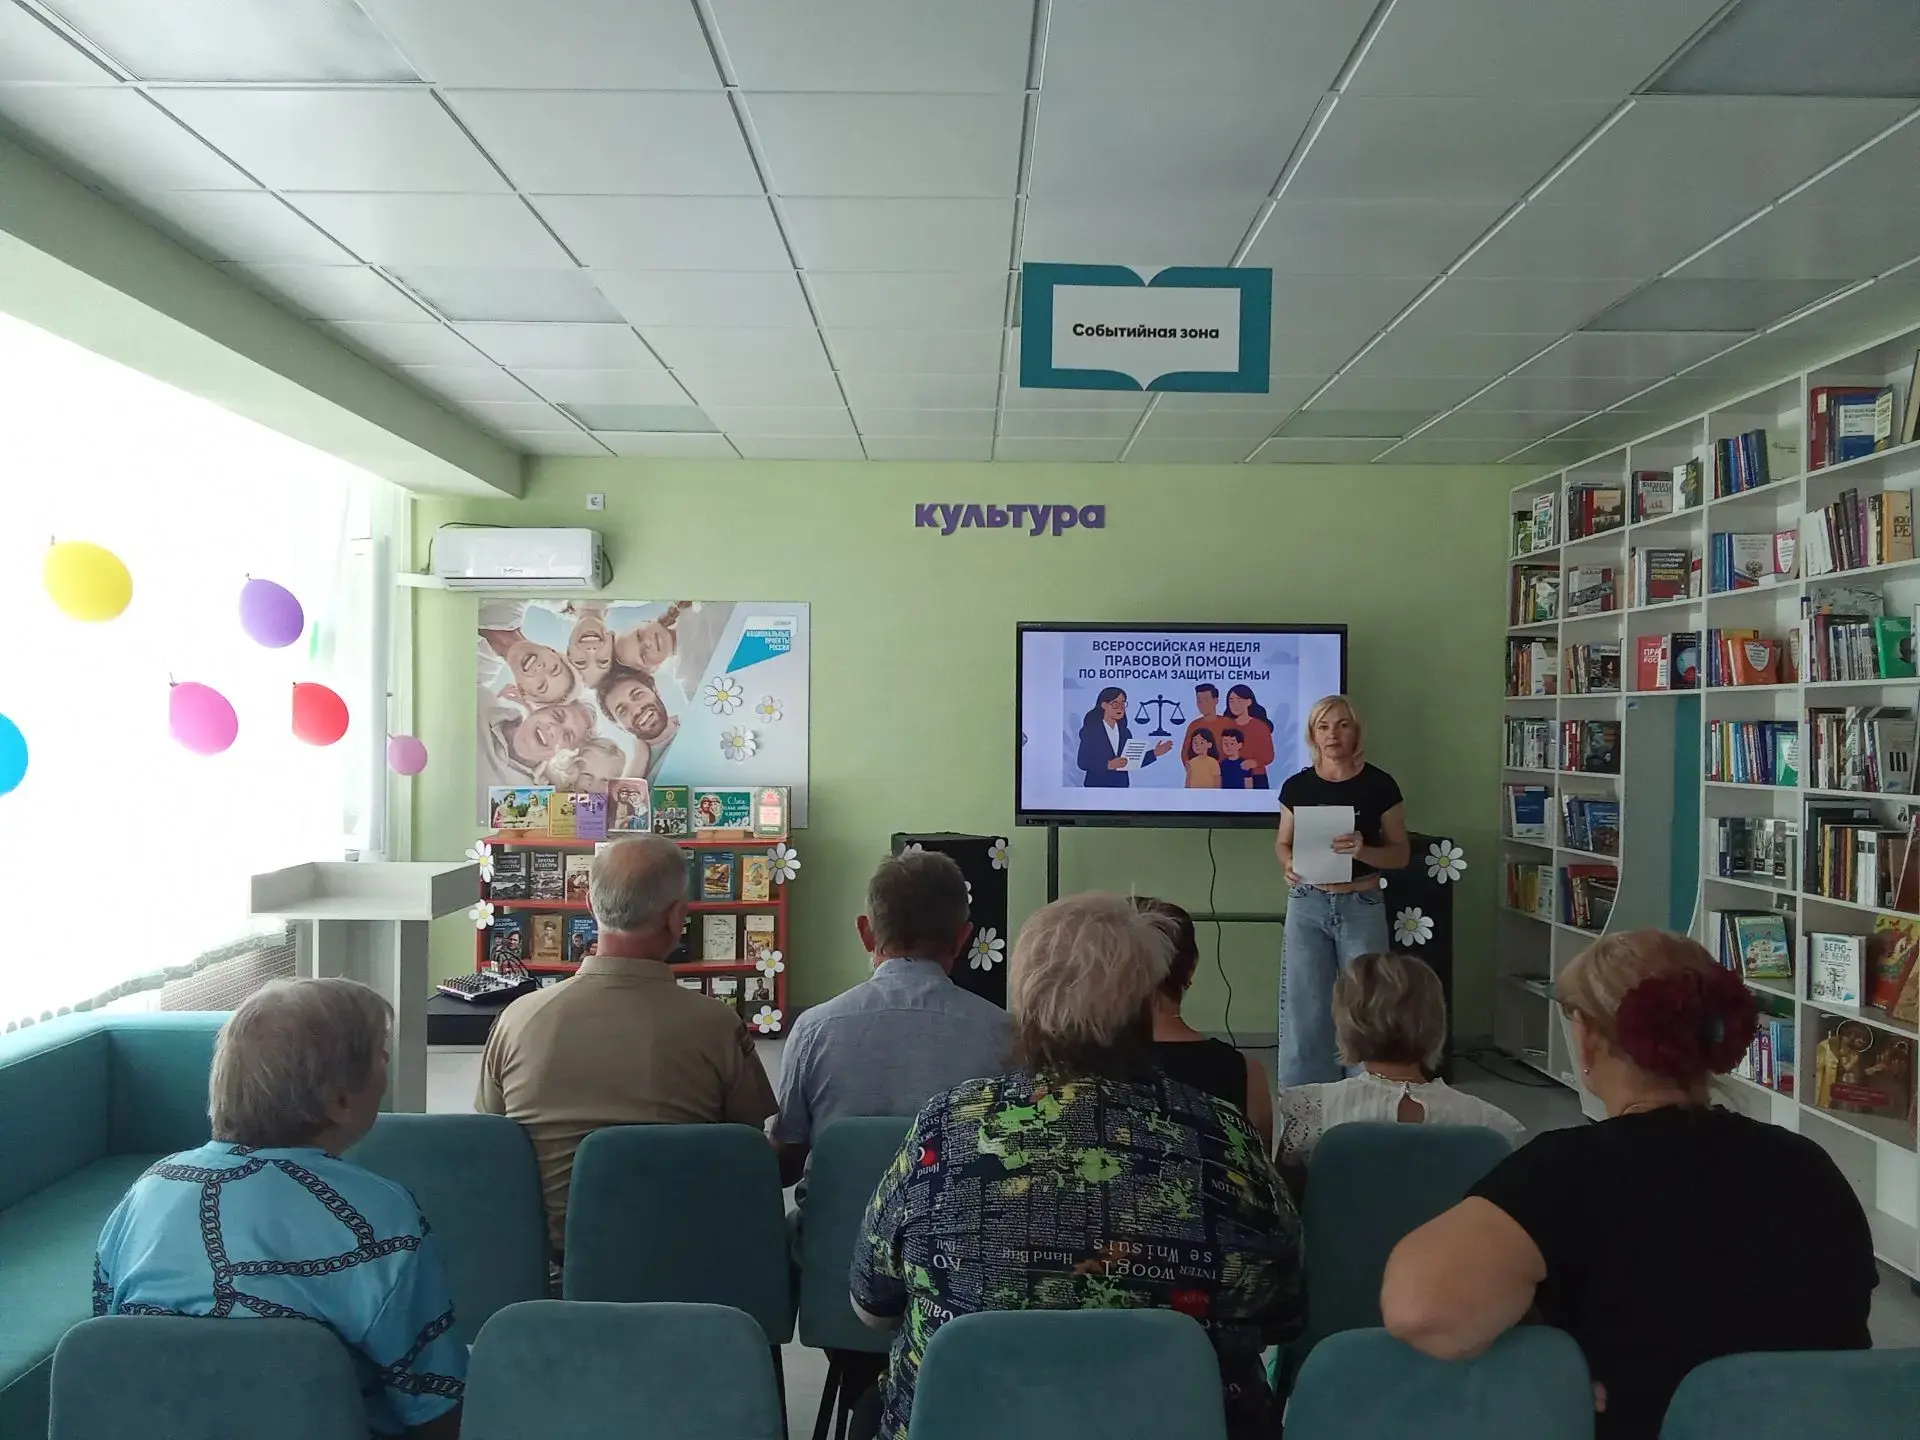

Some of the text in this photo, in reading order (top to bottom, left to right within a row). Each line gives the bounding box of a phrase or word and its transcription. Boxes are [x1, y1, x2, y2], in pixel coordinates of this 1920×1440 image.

[1072, 323, 1220, 339] Событийная зона
[915, 503, 1106, 537] культура
[1092, 638, 1261, 654] ВСЕРОССИЙСКАЯ НЕДЕЛЯ
[1104, 653, 1252, 669] ПРАВОВОЙ ПОМОЩИ
[1078, 669, 1270, 682] ПО ВОПРОСАМ ЗАЩИТЫ СЕМЬИ
[1034, 1250, 1074, 1265] Hand
